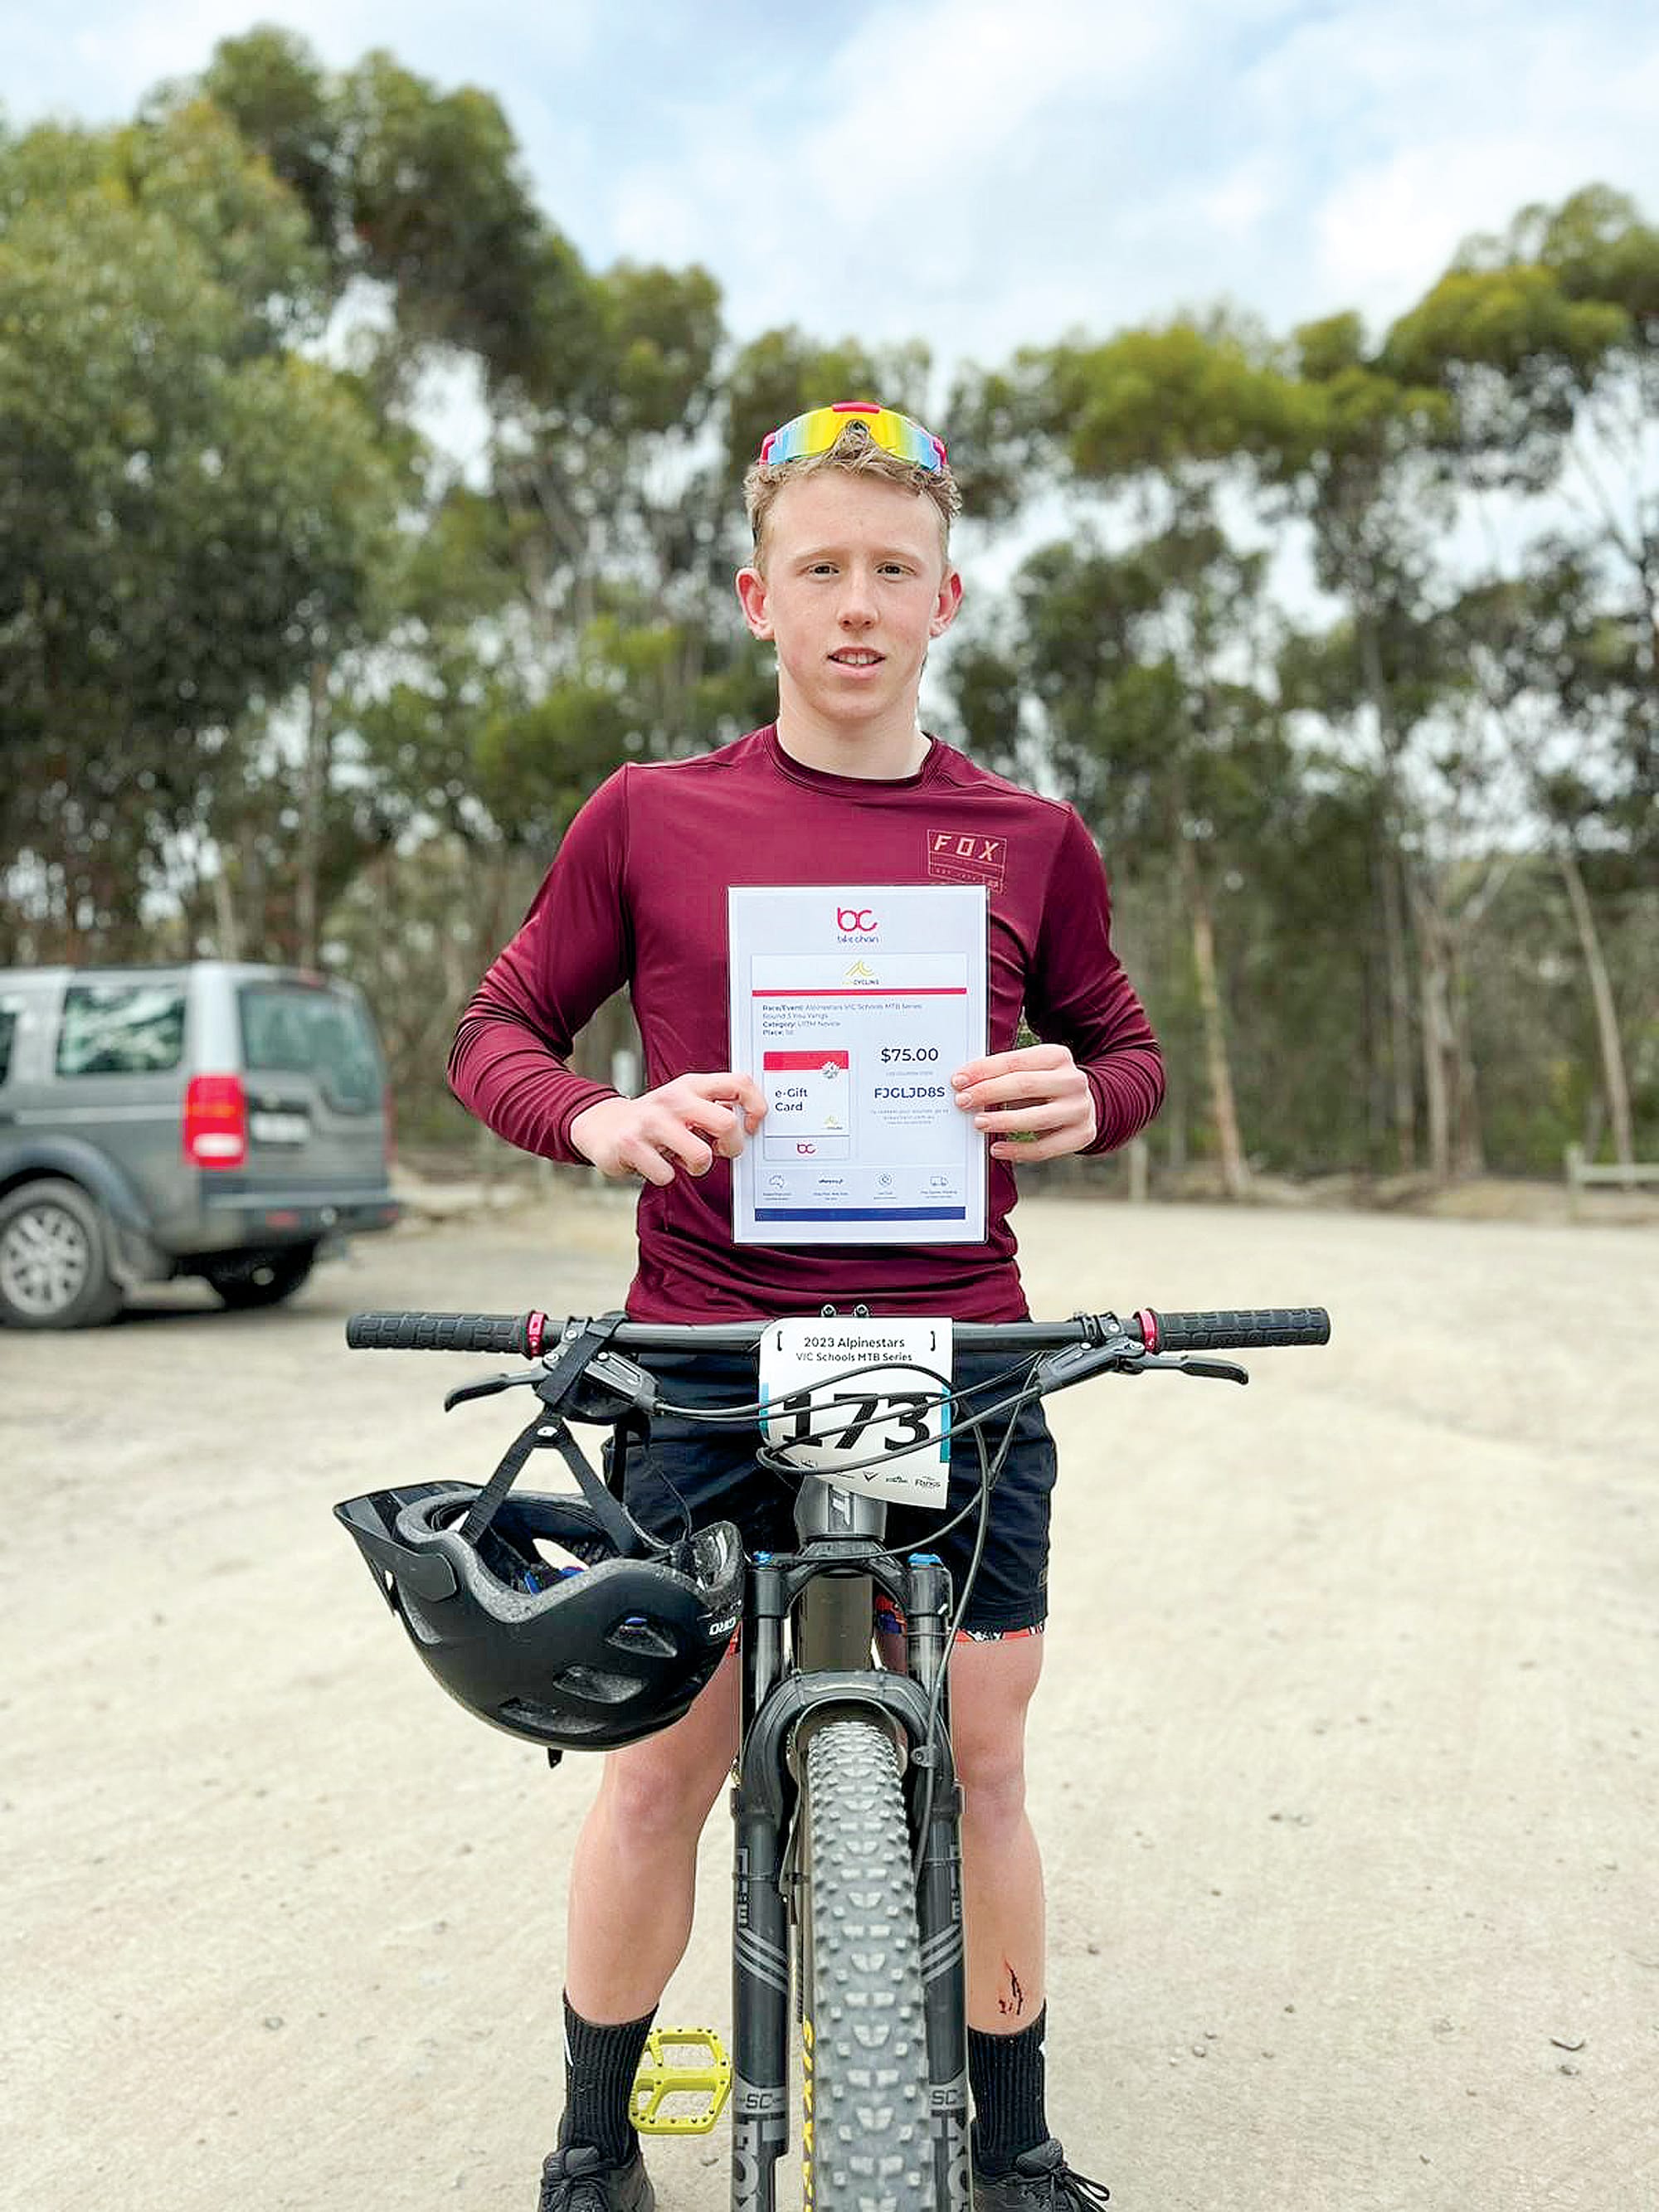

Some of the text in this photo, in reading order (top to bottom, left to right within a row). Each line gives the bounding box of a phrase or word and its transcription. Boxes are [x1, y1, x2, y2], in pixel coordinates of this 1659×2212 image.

[934, 834, 1000, 863] FOX
[881, 1047, 939, 1063] $75.00
[775, 1087, 808, 1099] e-Gift
[874, 1087, 946, 1099] FJGLJD8S
[775, 1101, 803, 1112] Card
[804, 1336, 905, 1349] 2023 Alpinestars
[795, 1352, 912, 1362] VIC Schools MTB Series
[782, 1391, 931, 1451] 173
